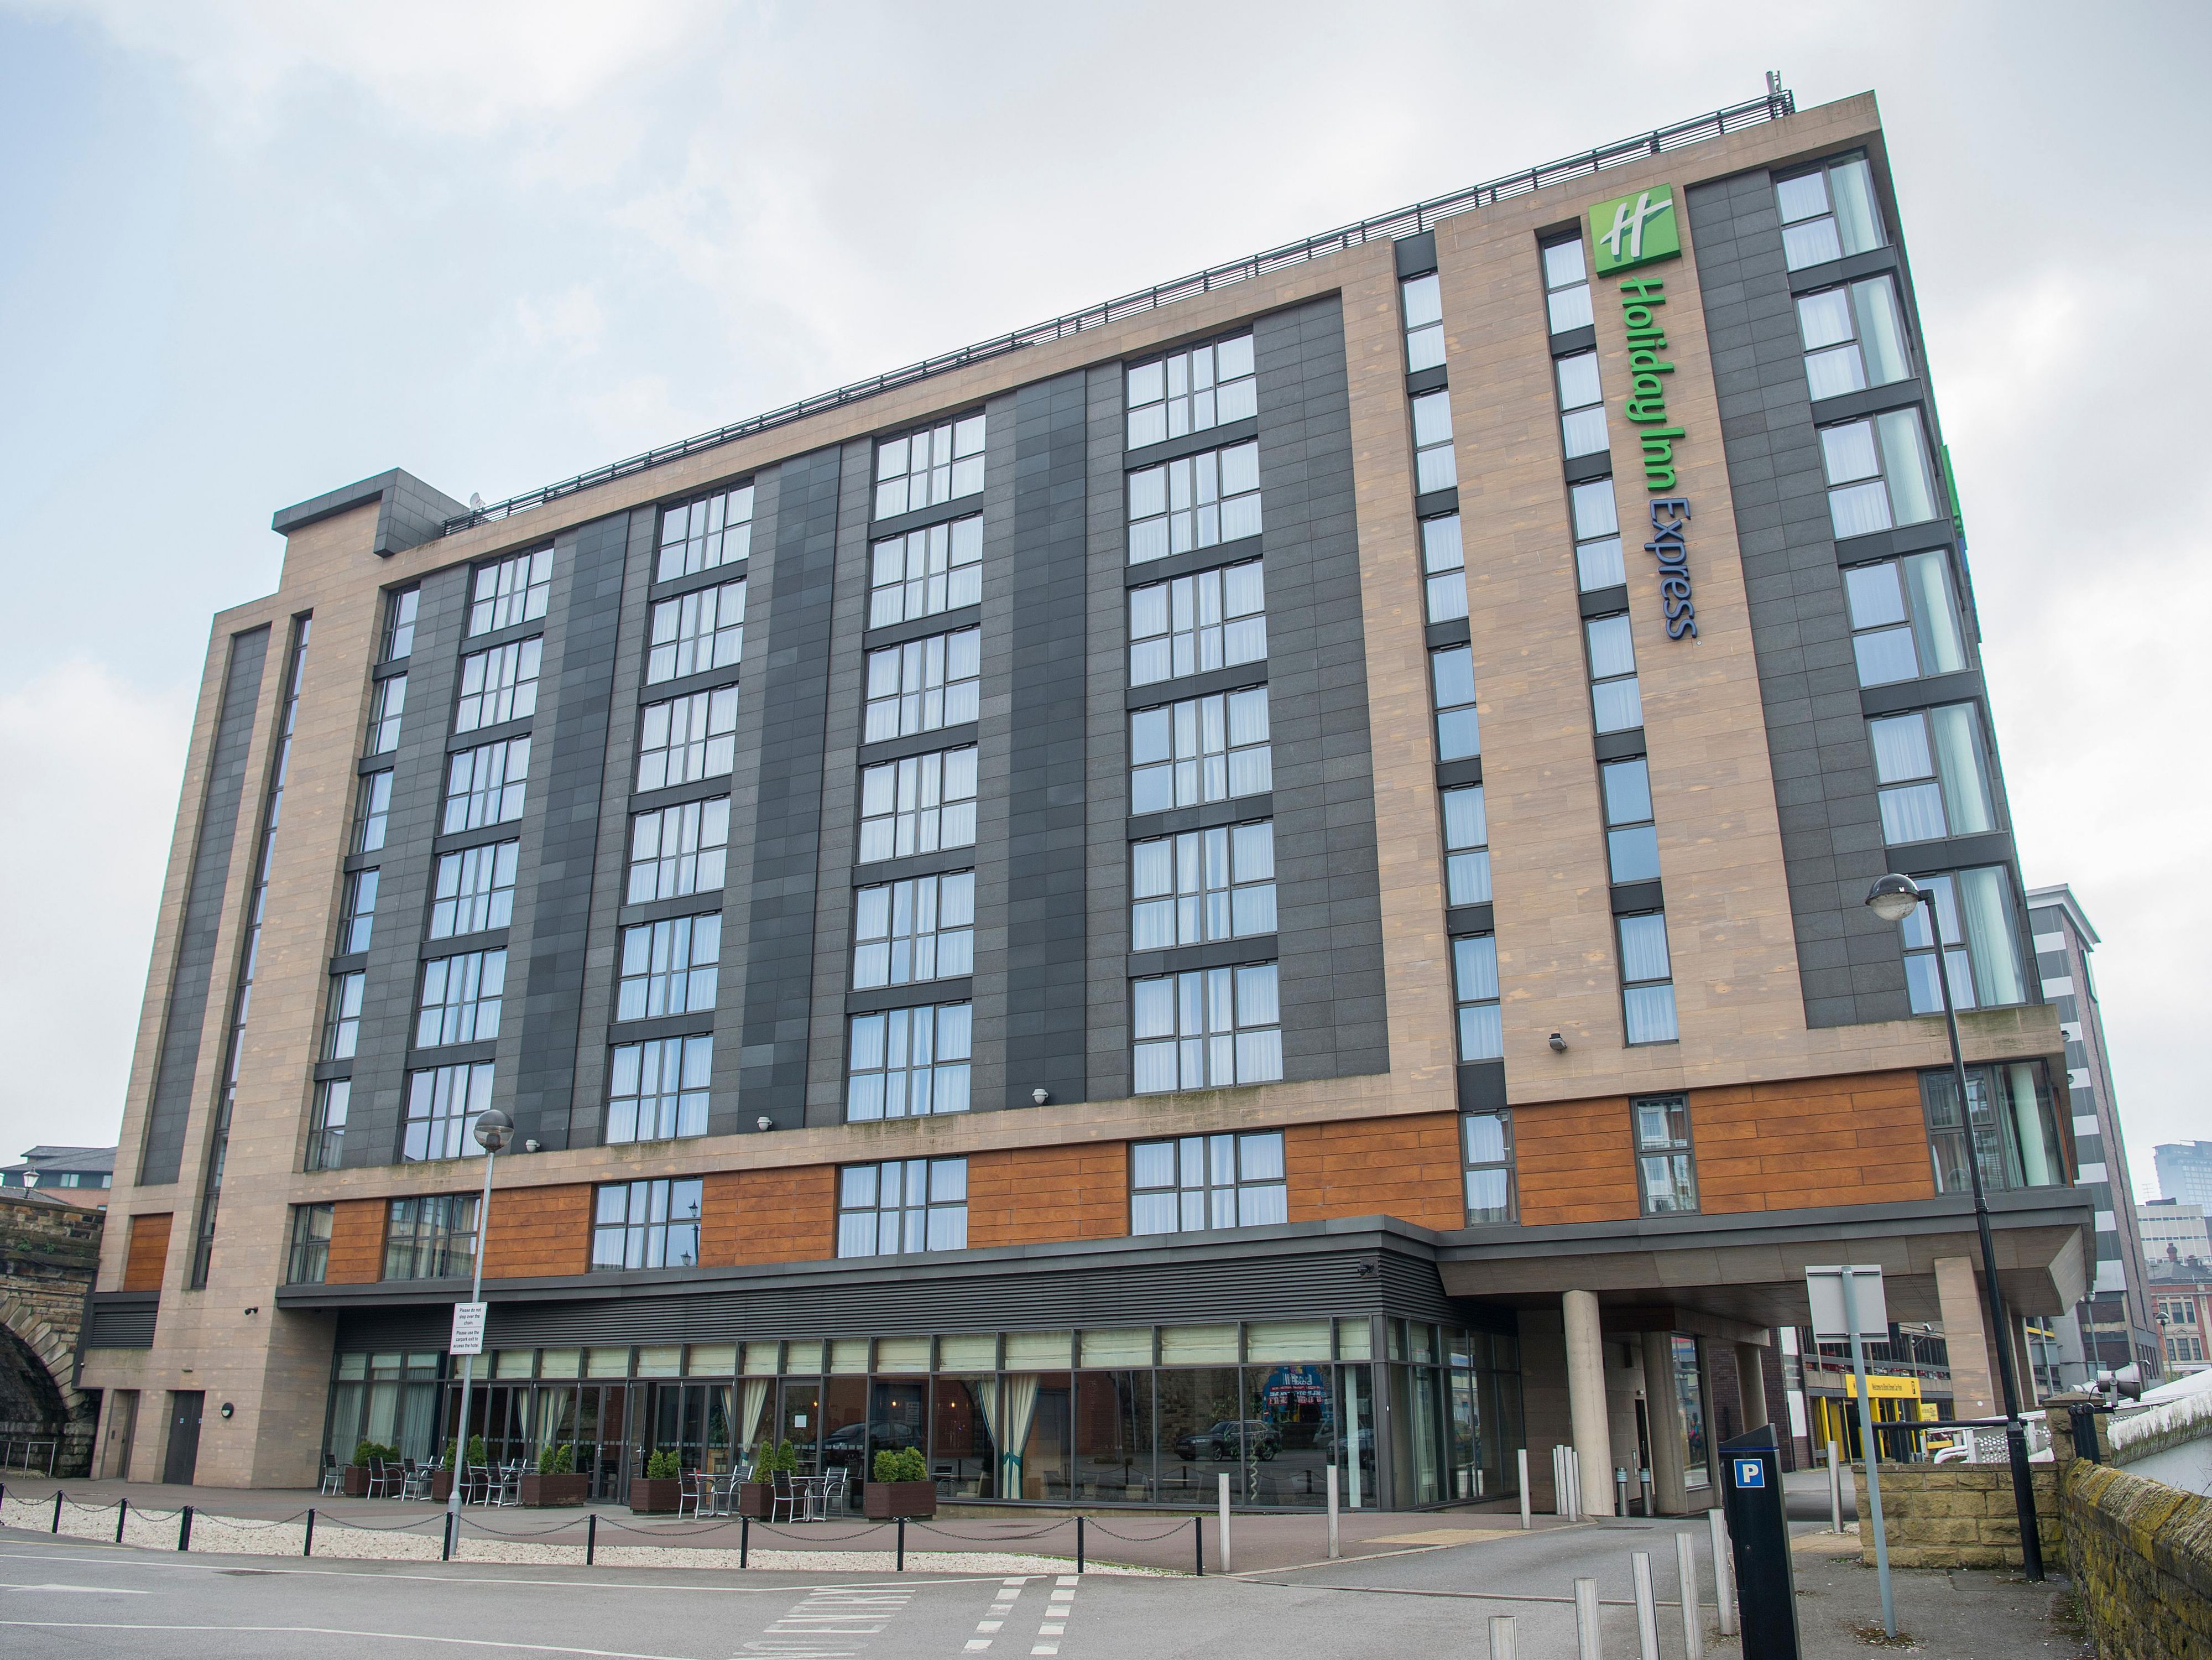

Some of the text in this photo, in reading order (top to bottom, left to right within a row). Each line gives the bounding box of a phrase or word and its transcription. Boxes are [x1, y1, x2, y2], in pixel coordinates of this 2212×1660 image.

[1620, 277, 1698, 641] Holiday Inn Express
[1743, 1464, 1759, 1482] P
